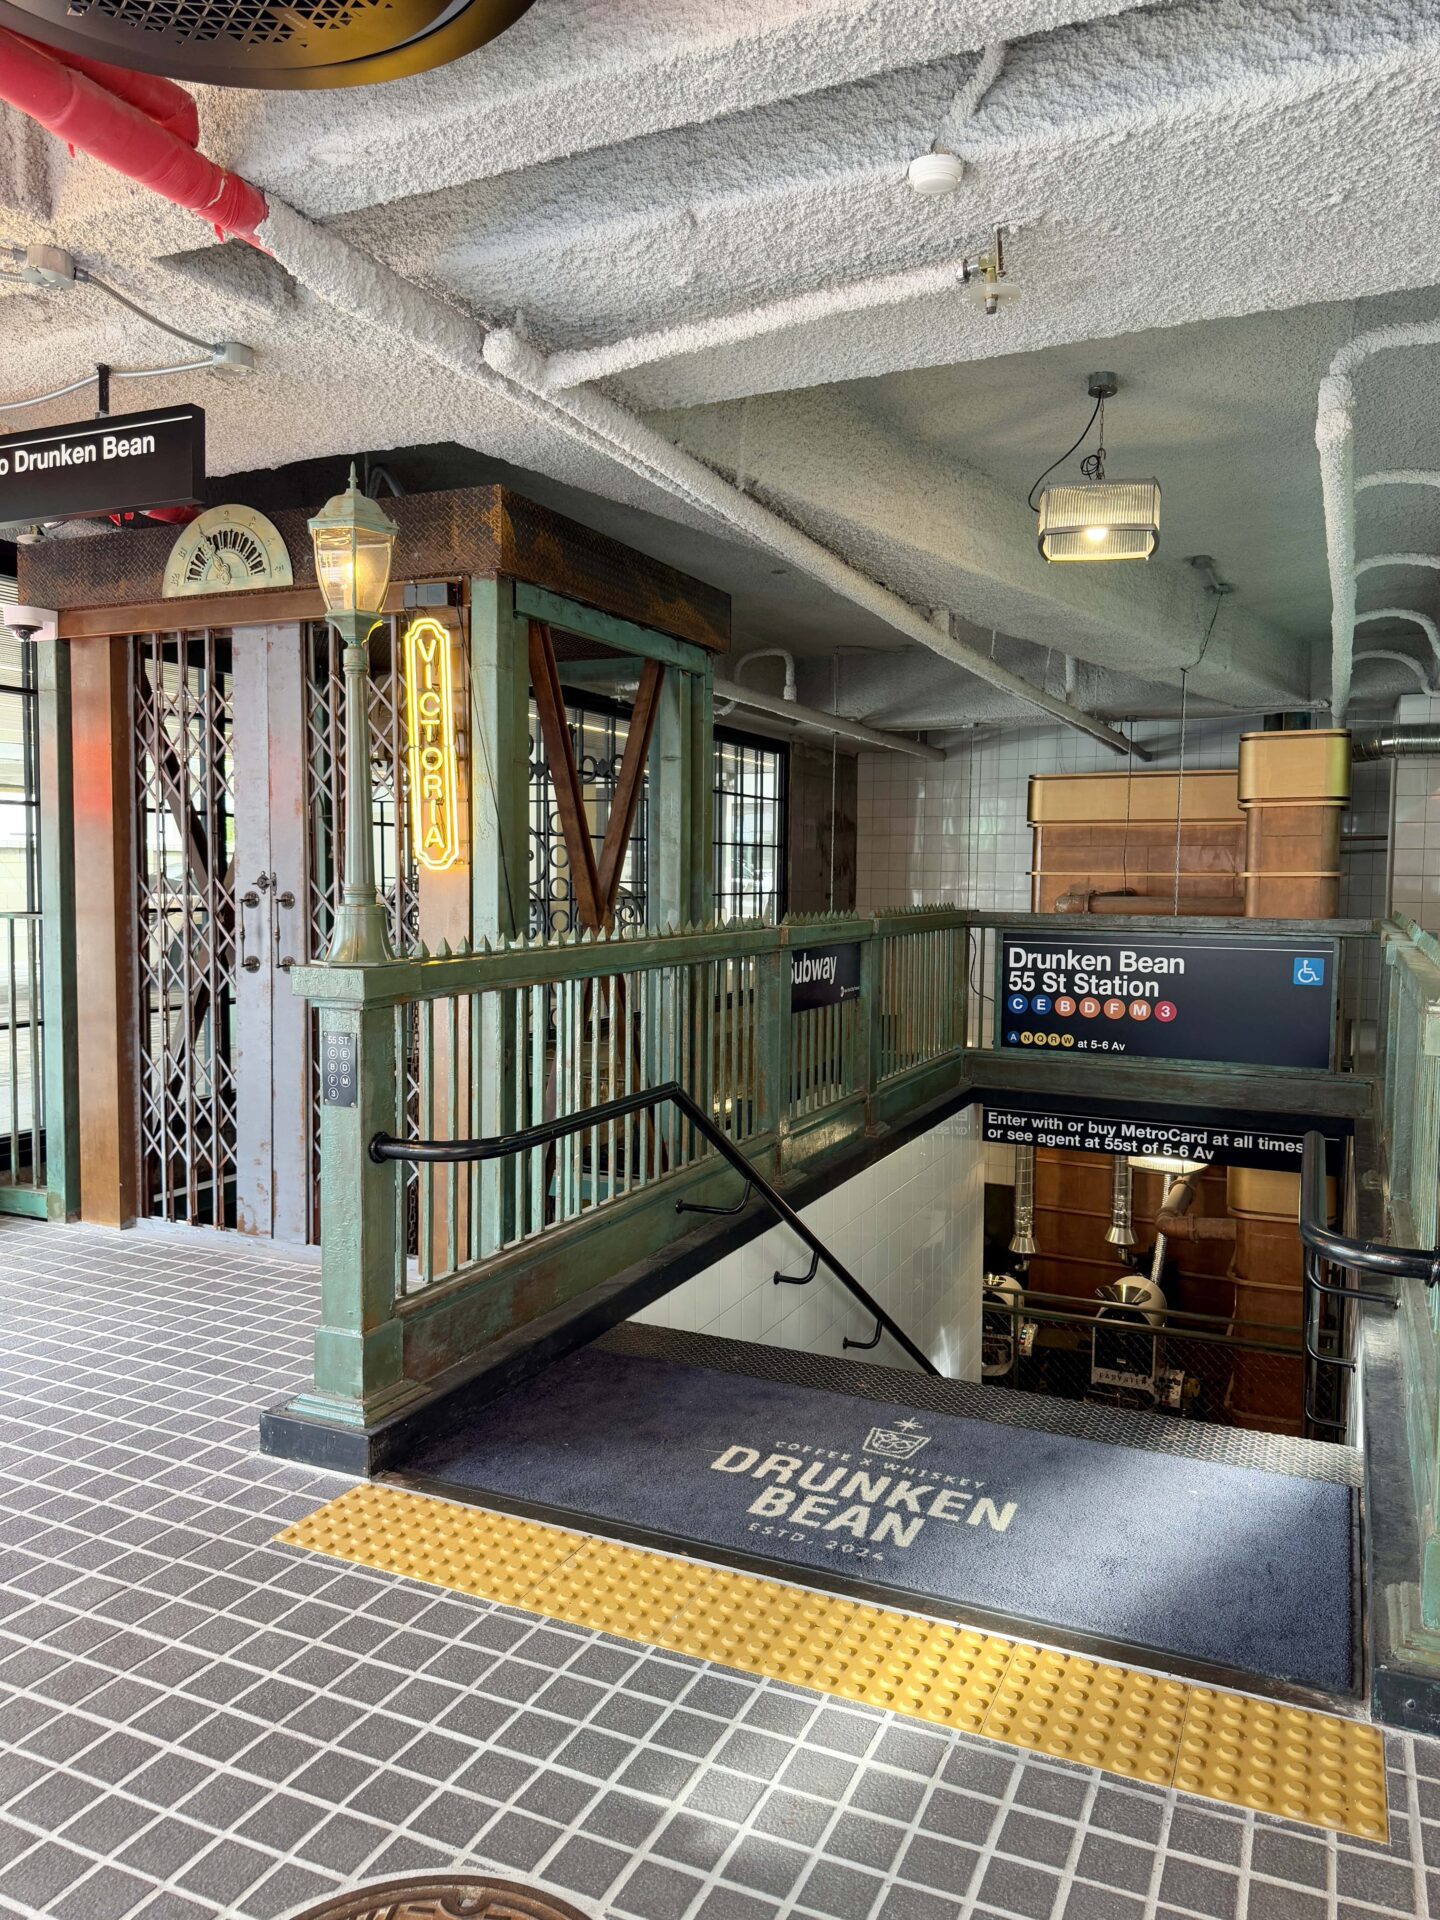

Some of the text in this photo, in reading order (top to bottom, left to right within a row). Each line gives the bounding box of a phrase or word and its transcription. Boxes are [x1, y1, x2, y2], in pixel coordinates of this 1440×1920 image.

[14, 444, 96, 473] Drunken
[103, 435, 156, 460] Bean
[417, 638, 445, 849] VICTORIA
[1009, 947, 1185, 974] Drunken Bean
[1008, 971, 1159, 998] 55 St Station
[328, 1036, 350, 1046] 55 ST.
[1078, 1040, 1088, 1048] at
[1090, 1040, 1108, 1050] 5-6
[1112, 1041, 1126, 1051] Av
[988, 1112, 1303, 1153] Enter with or buy MetroCard at all times
[988, 1128, 1214, 1160] or see agent at 55st of 5-6 Av
[775, 1441, 850, 1461] COFFEE
[883, 1462, 986, 1489] WHISKEY
[710, 1445, 1018, 1532] DRUNKEN
[746, 1486, 926, 1548] BEAN
[825, 1540, 884, 1561] 2024
